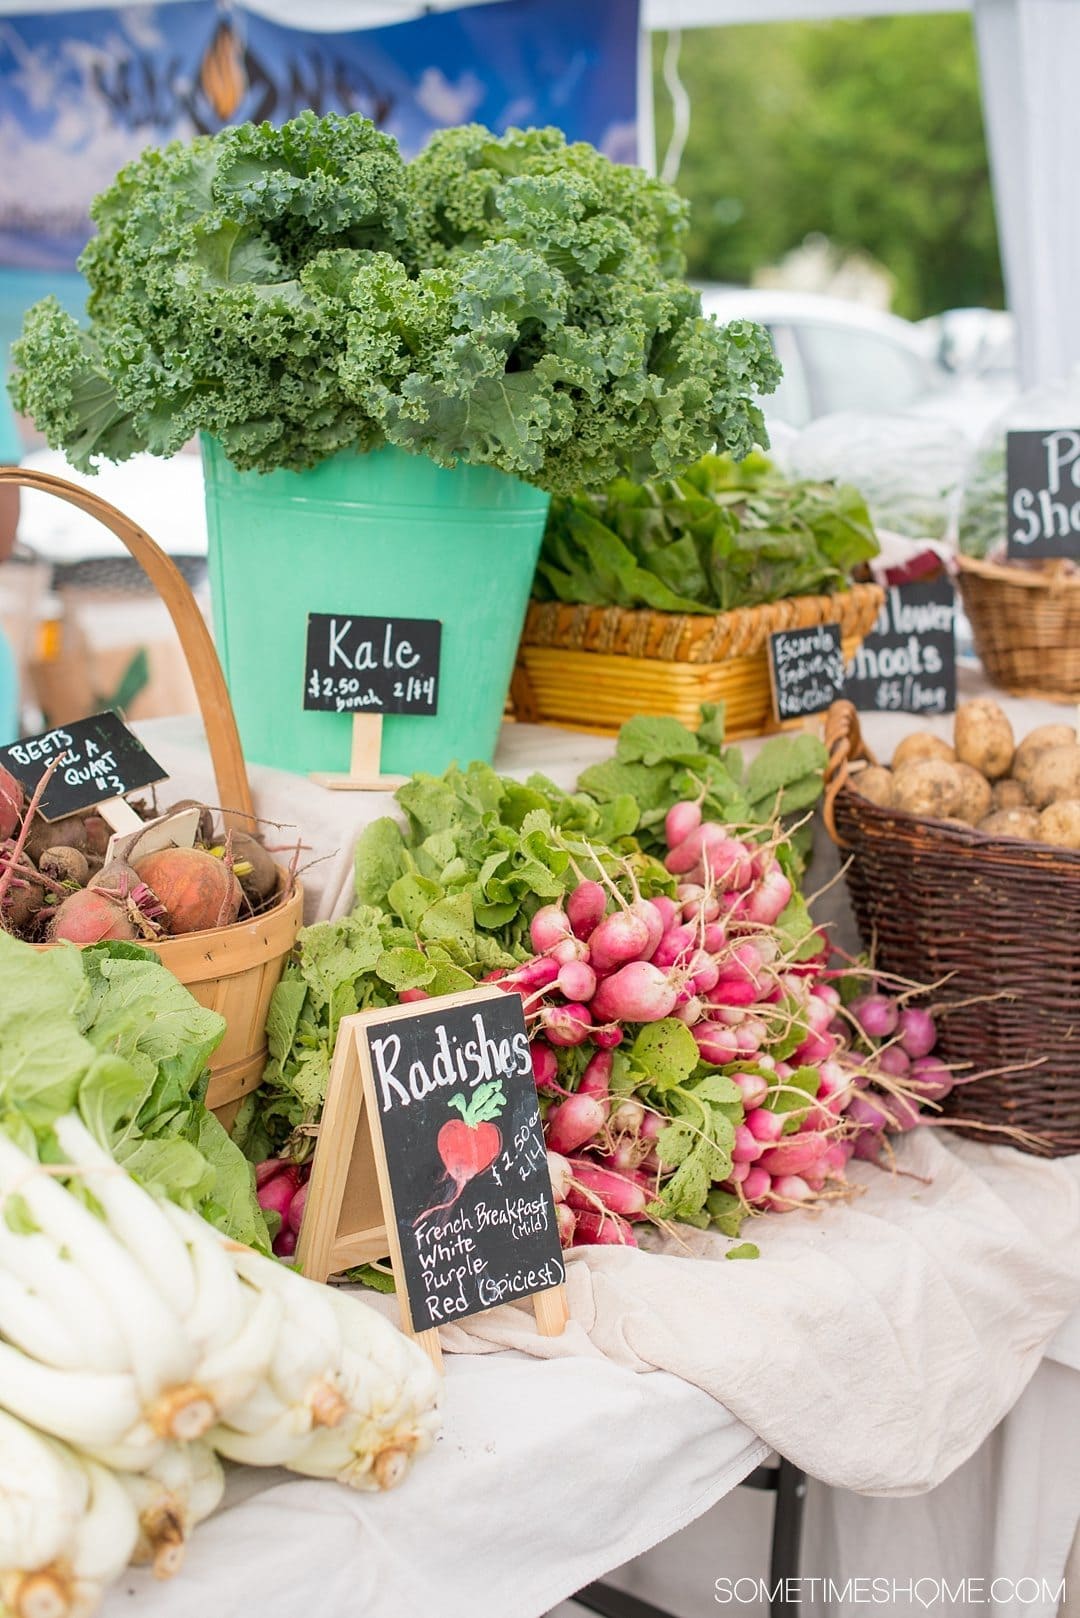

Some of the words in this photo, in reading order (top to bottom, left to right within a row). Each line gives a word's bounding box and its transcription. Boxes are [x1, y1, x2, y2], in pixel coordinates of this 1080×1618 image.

[329, 619, 420, 670] Kale
[308, 669, 359, 698] $2.50
[8, 730, 73, 765] BEETS
[85, 739, 99, 758] A
[64, 751, 117, 785] QUART
[371, 1013, 533, 1112] Radishes
[414, 1208, 473, 1250] French
[474, 1193, 548, 1232] Breakfast
[512, 1212, 548, 1240] (Mild)
[419, 1235, 476, 1270] White
[422, 1255, 488, 1292] Purple
[425, 1286, 469, 1320] Red
[479, 1258, 565, 1306] (Spiciest)
